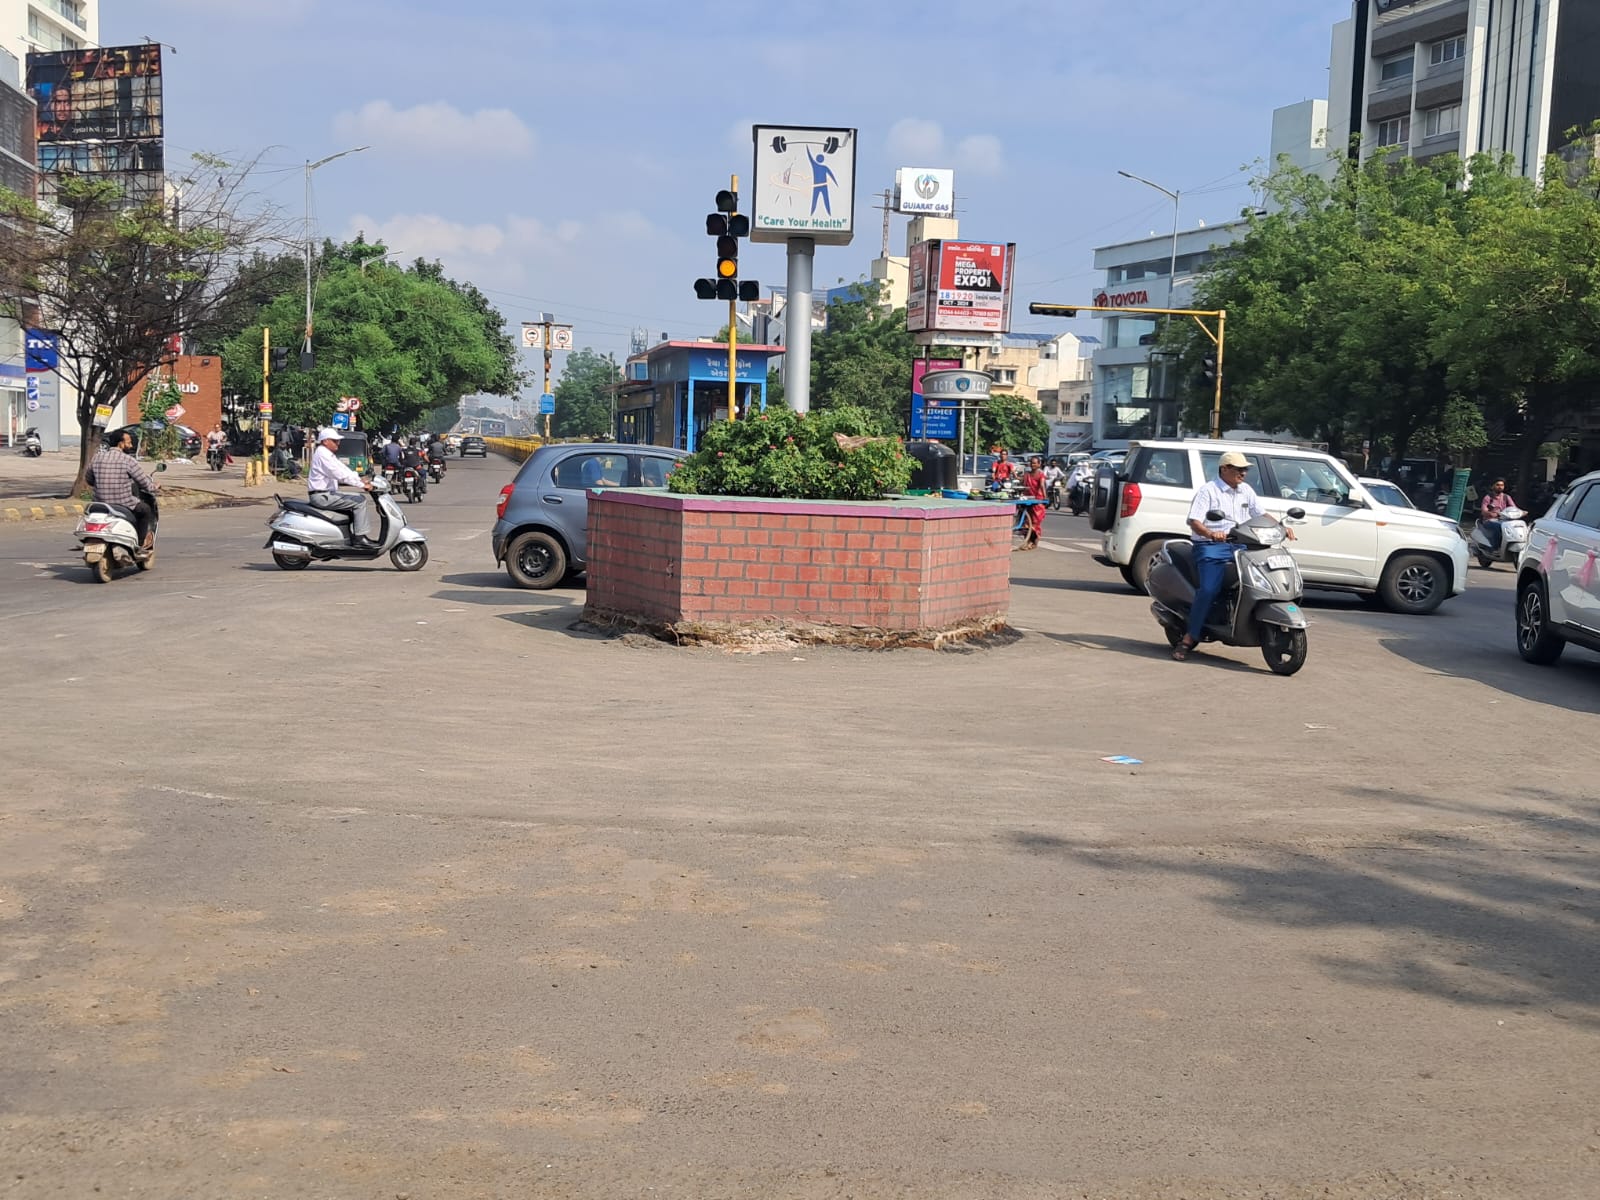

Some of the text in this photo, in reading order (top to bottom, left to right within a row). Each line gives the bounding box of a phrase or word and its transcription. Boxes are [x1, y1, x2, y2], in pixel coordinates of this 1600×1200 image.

[903, 202, 949, 211] GUJARAT GAS
[788, 217, 809, 227] Your
[955, 260, 976, 268] MEGA
[954, 267, 992, 276] PROPERTY
[953, 275, 987, 287] EXPO
[1110, 290, 1148, 307] TOYOTA
[28, 339, 54, 349] TVS
